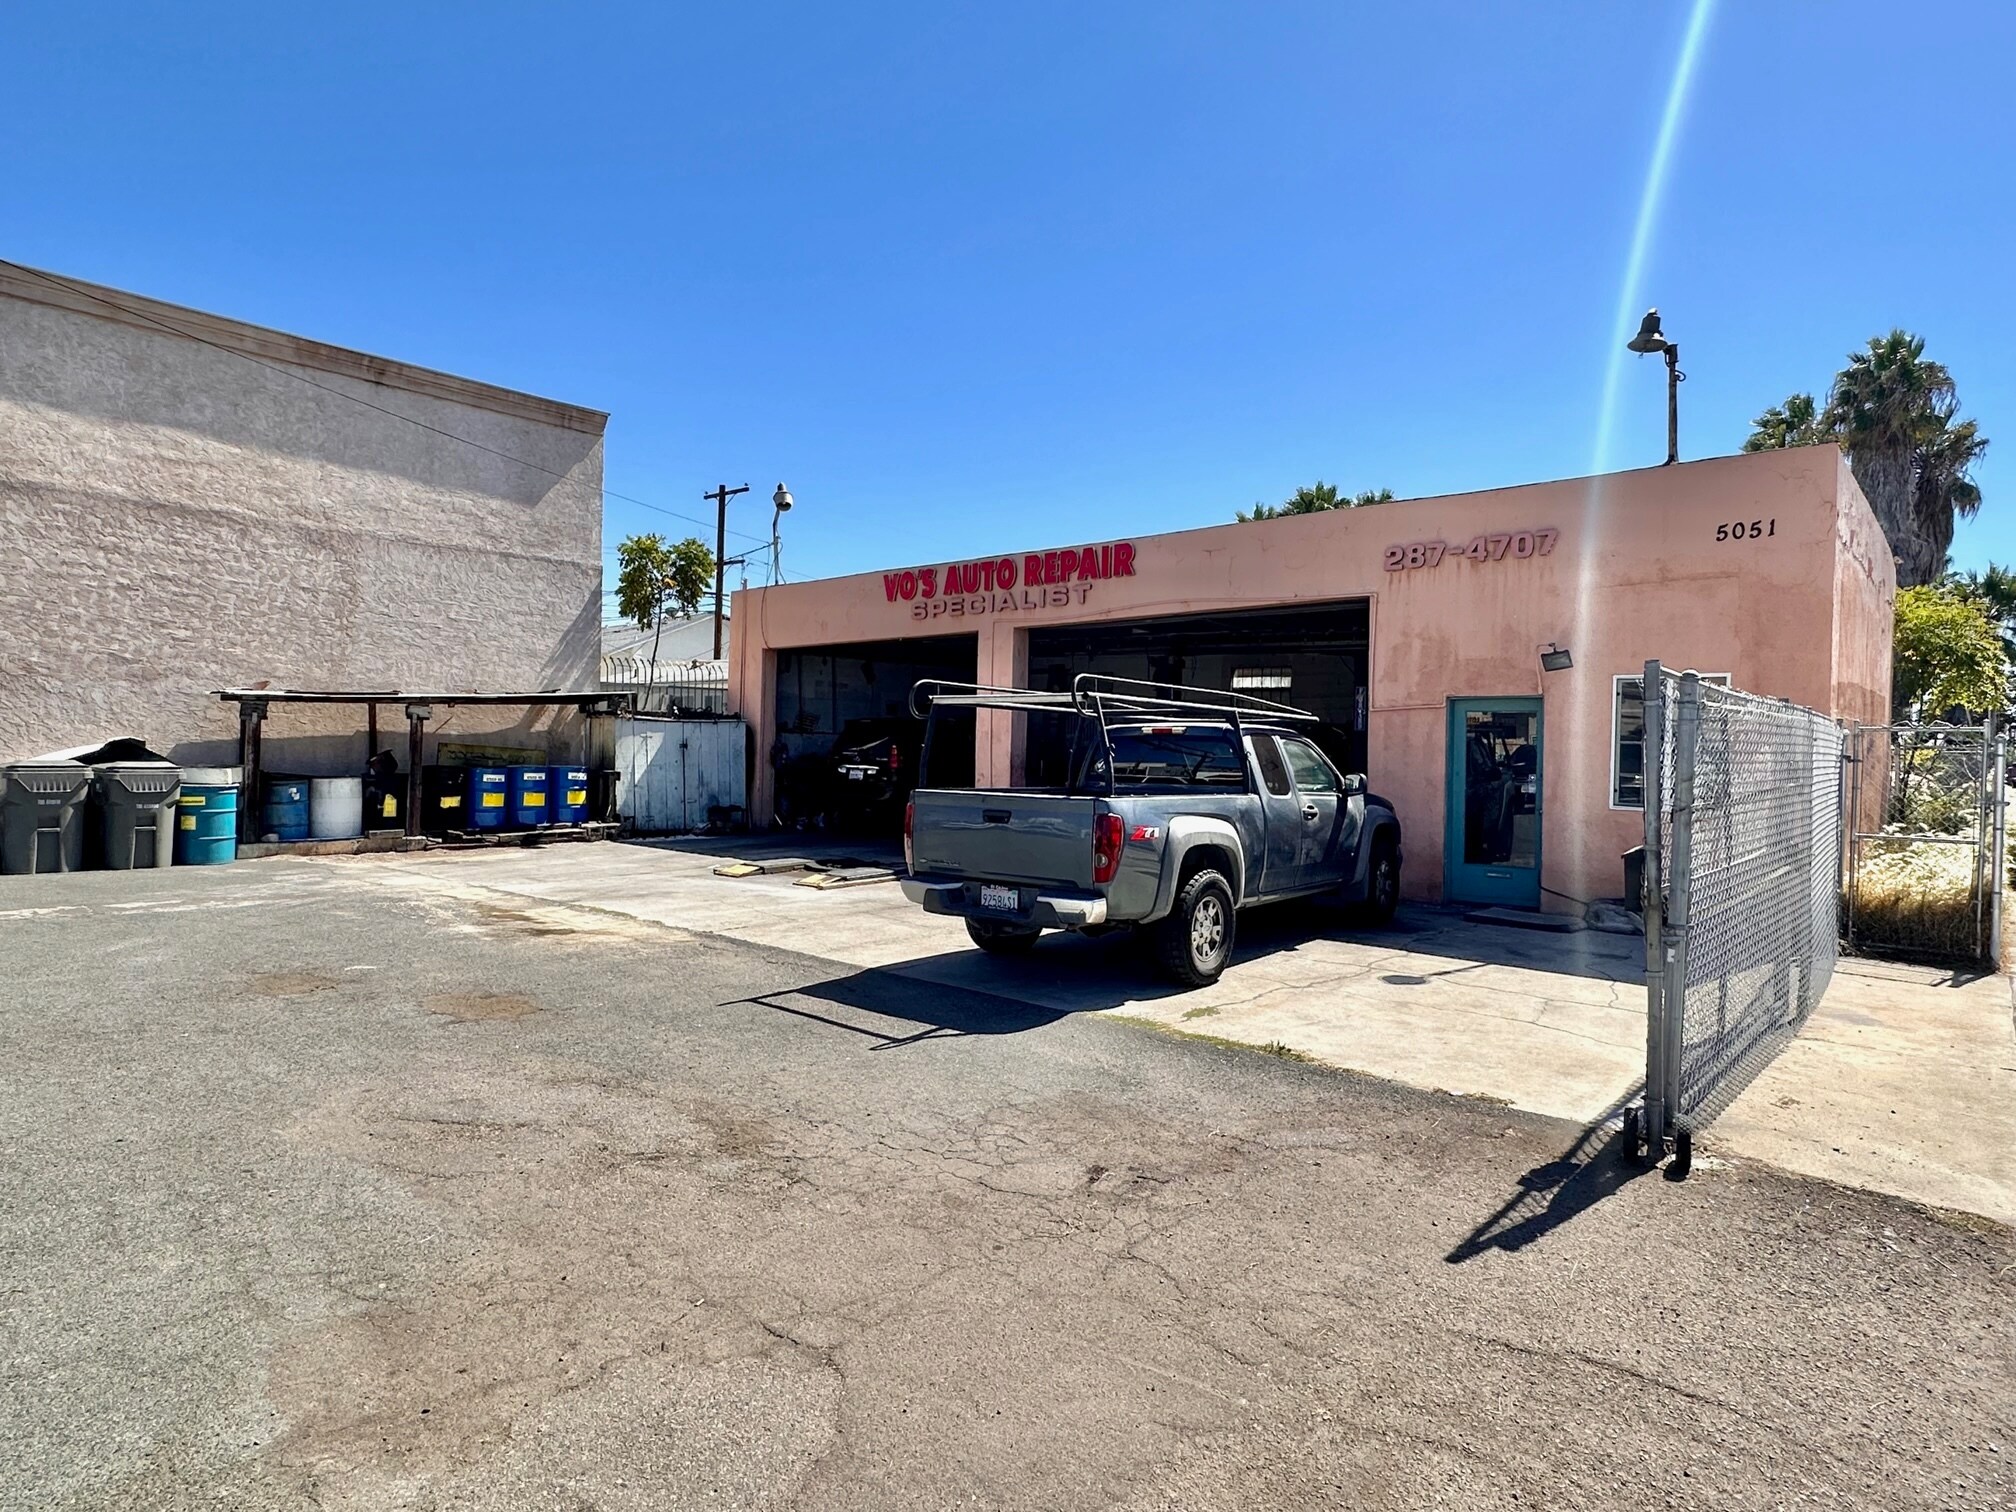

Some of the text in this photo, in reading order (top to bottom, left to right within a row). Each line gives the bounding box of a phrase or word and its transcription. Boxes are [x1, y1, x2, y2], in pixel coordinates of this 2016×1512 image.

[1383, 527, 1560, 572] 287-4707
[1715, 518, 1776, 542] 5051
[883, 542, 1136, 602] VO'S AUTO REPAIR
[910, 582, 1093, 621] SPECIALIST
